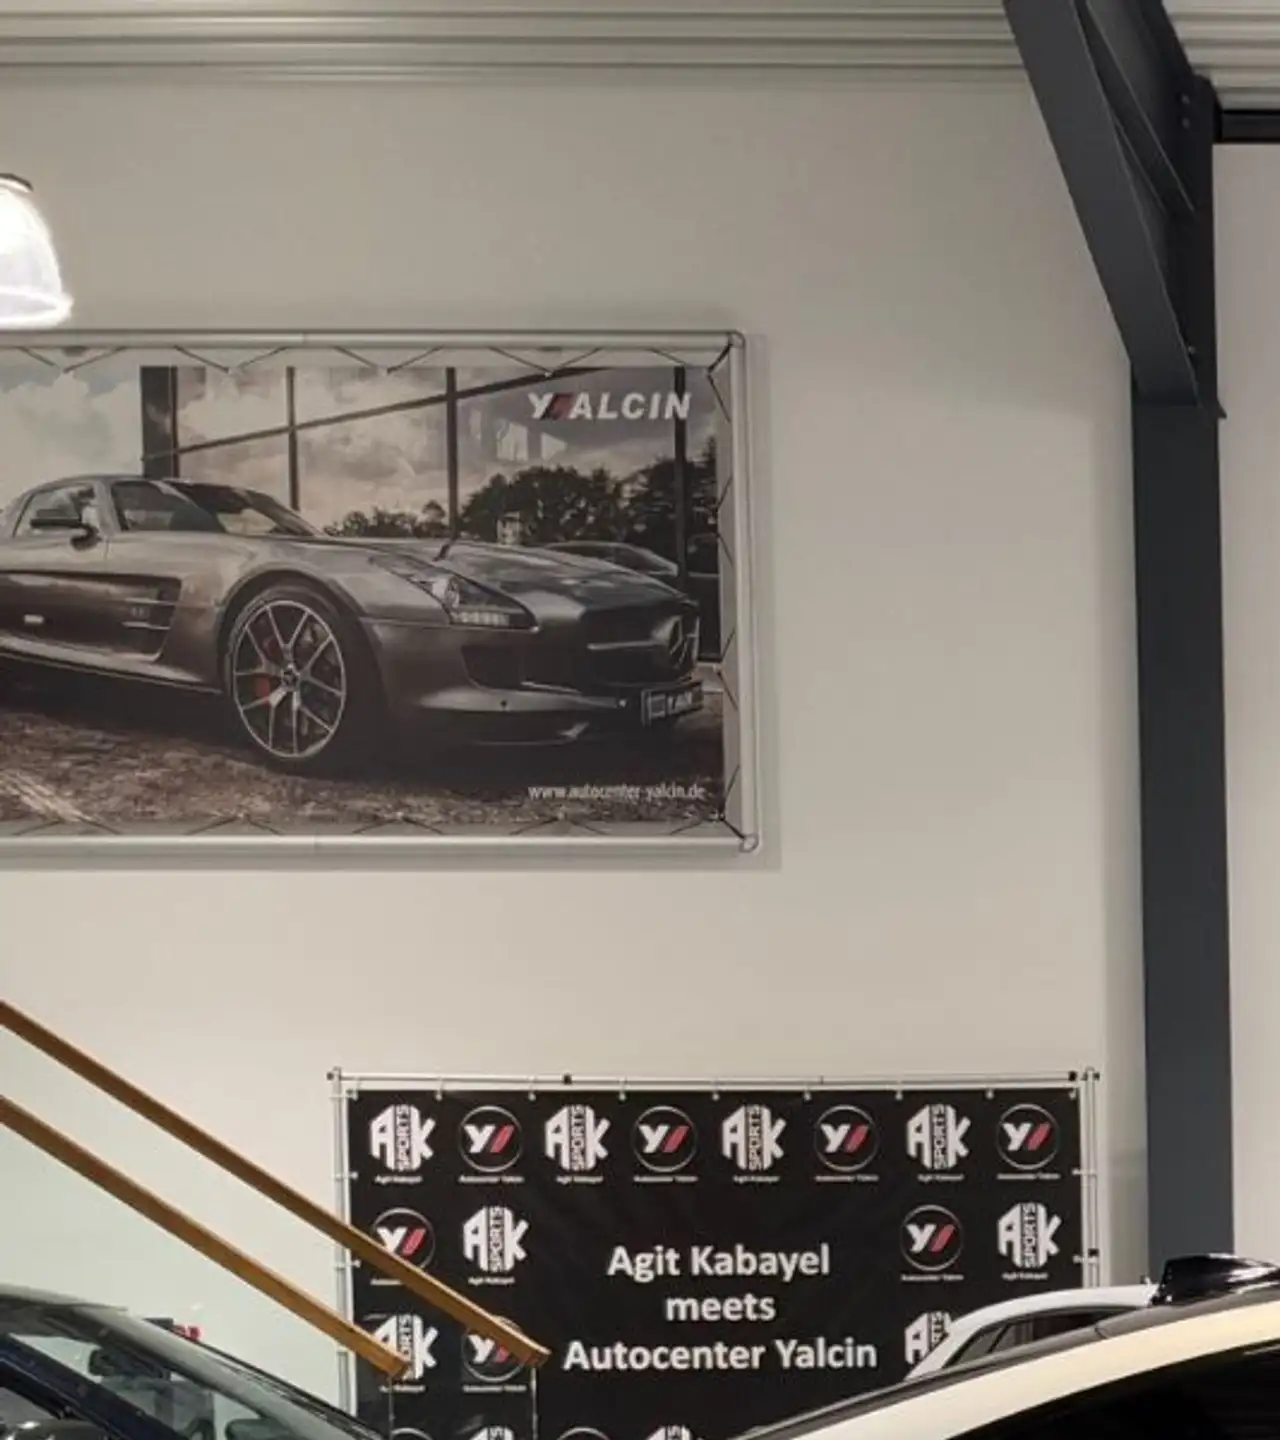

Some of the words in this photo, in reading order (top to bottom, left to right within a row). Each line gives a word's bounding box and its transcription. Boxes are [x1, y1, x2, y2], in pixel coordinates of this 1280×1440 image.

[527, 391, 693, 420] YALCIN
[606, 1245, 681, 1283] Agit
[690, 1242, 831, 1282] Kabayel
[664, 1293, 777, 1321] meets
[562, 1340, 766, 1371] Autocenter
[773, 1336, 878, 1369] Yalcin
